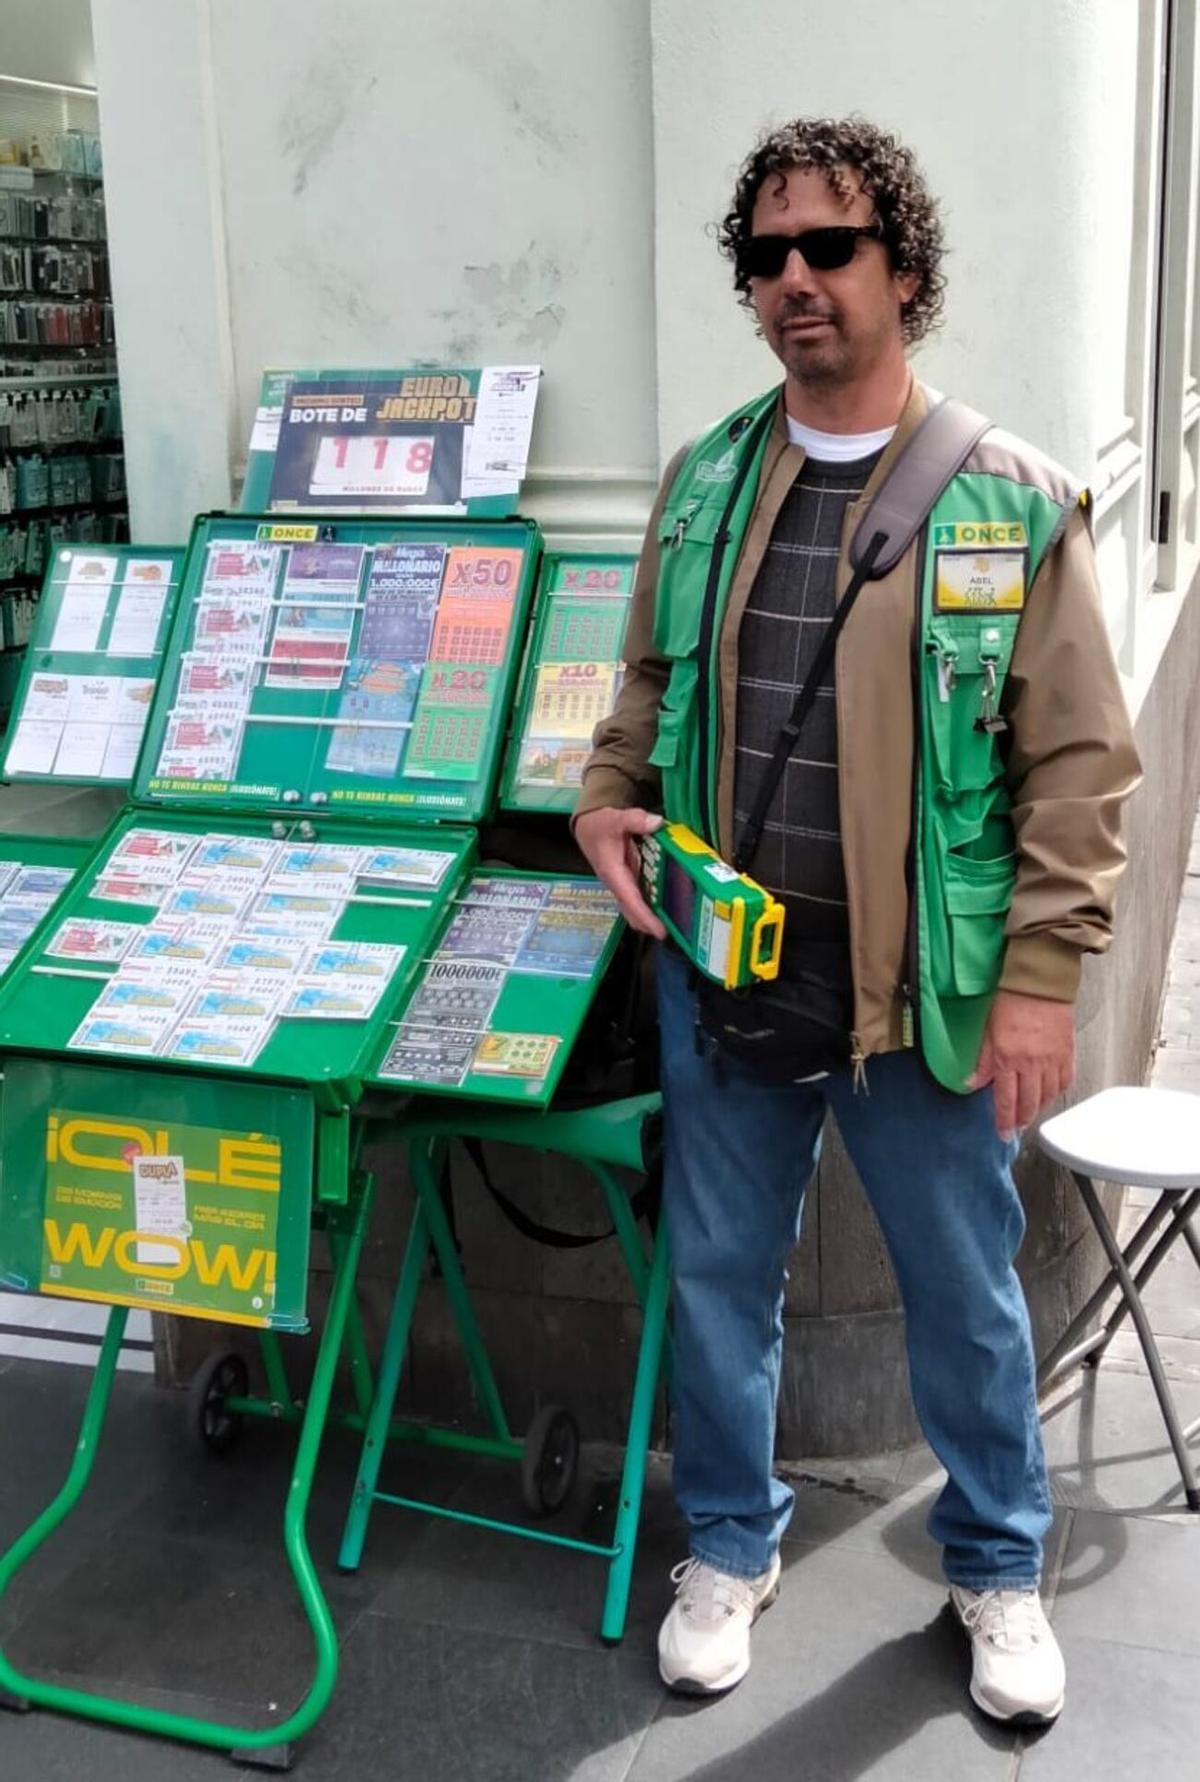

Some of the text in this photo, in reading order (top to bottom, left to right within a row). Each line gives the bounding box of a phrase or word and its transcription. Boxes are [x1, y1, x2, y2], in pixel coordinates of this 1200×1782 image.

[402, 375, 465, 397] EURO
[289, 407, 368, 423] BOTE DE
[376, 397, 476, 422] JACKPOT
[273, 527, 313, 539] ONCE
[961, 527, 1021, 542] ONCE
[452, 558, 512, 586] x50
[970, 577, 993, 585] ABEL
[43, 1218, 277, 1294] WOW!
